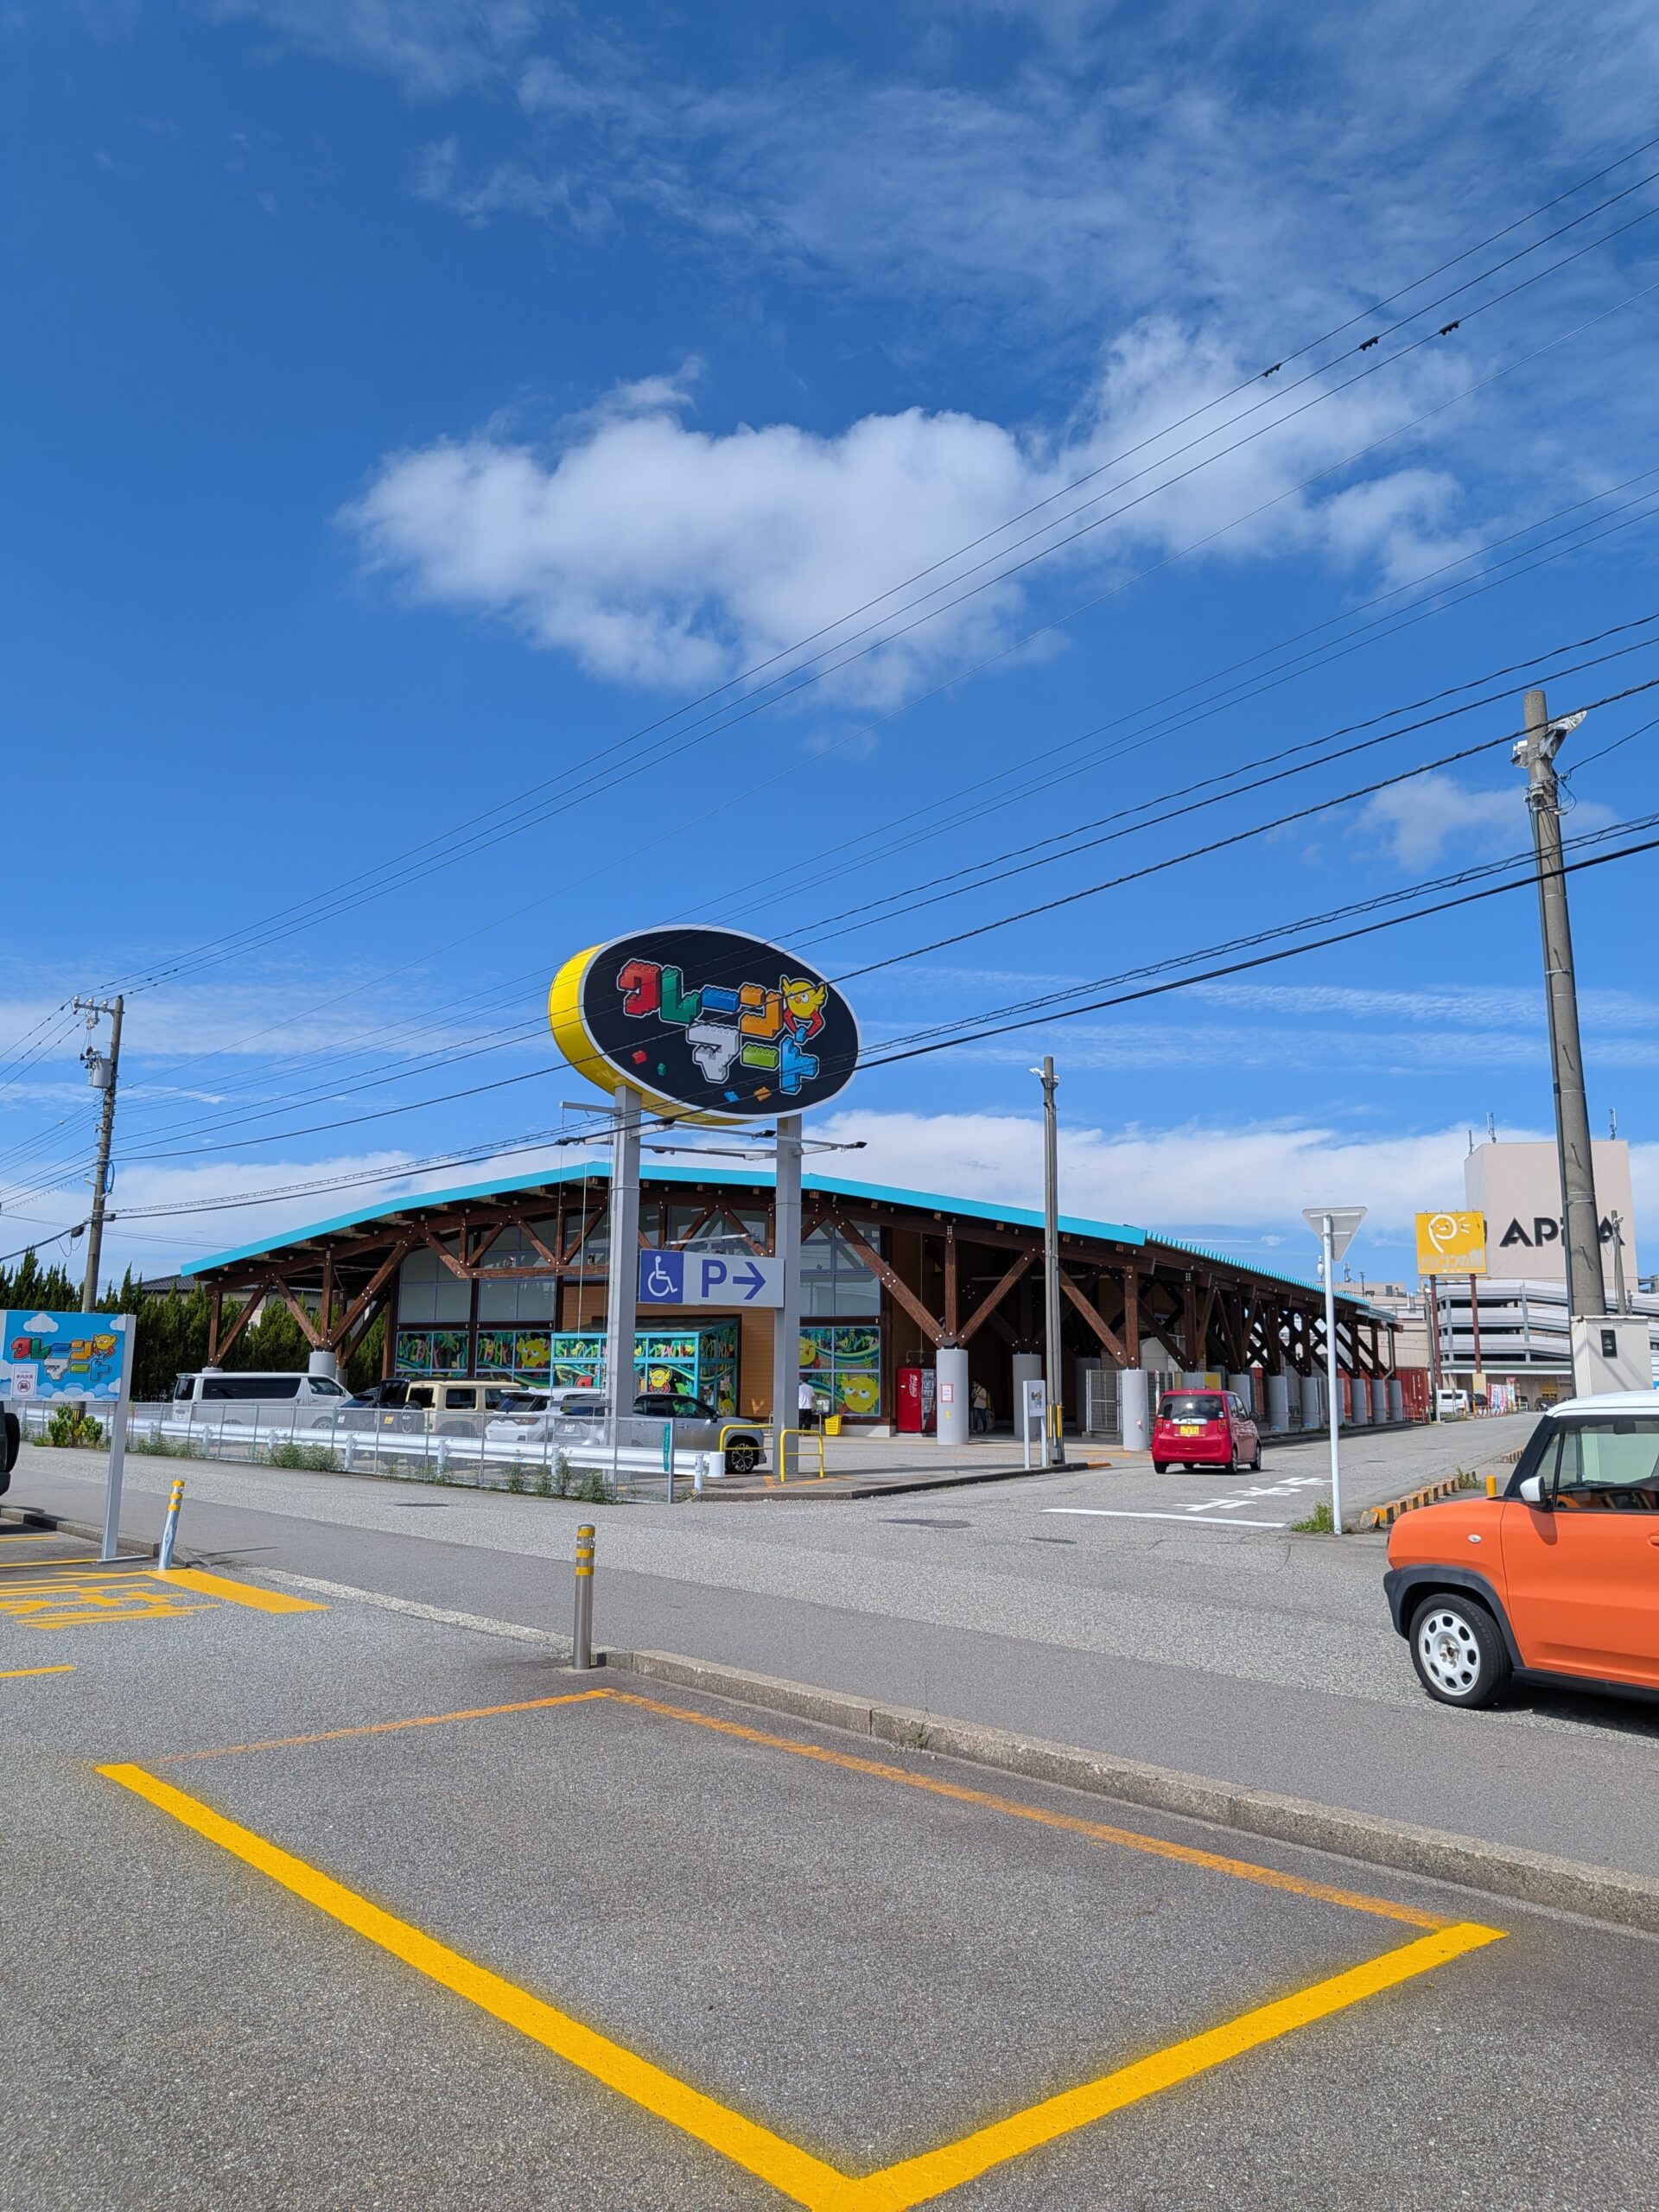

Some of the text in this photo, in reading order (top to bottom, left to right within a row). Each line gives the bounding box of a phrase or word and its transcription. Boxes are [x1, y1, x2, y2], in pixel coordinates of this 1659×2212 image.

[617, 958, 784, 1039] クレーン
[686, 1020, 820, 1095] マート
[701, 1259, 727, 1298] P
[10, 1337, 94, 1361] クレーン
[43, 1357, 111, 1382] マート
